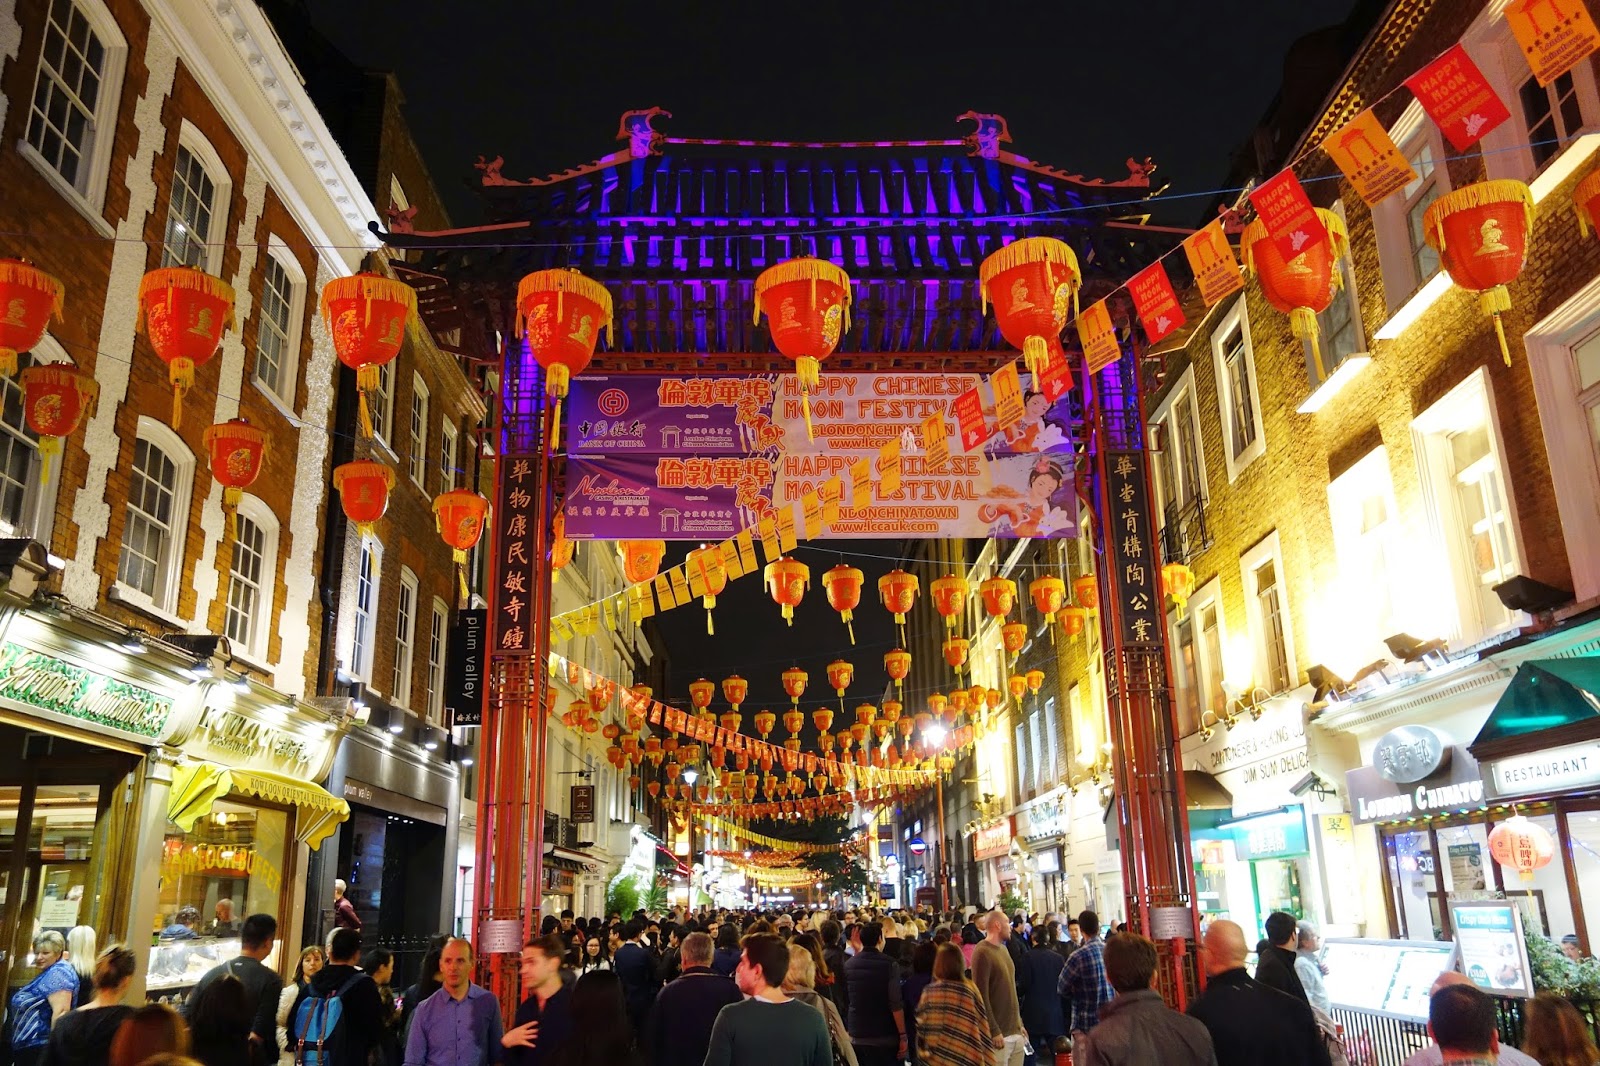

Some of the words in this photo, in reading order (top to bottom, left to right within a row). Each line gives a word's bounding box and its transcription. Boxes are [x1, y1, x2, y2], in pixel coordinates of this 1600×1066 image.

[1420, 57, 1460, 93] HAPPY
[1431, 72, 1466, 102] MOON
[1432, 80, 1480, 116] FESTIVAL
[1259, 179, 1291, 207] HAPPY
[1268, 192, 1295, 217] MOON
[1268, 201, 1305, 229] FESTIVAL
[1136, 271, 1160, 294] HAPPY
[1140, 282, 1162, 303] MOON
[1140, 290, 1169, 314] FESTIVAL
[657, 378, 773, 408] 倫敦華埠
[784, 376, 857, 396] HAPPY
[873, 376, 976, 396] CHINESE
[858, 399, 958, 419] FESTIVA
[578, 420, 646, 438] 中國銀行
[655, 457, 773, 489] 倫敦華埠
[784, 456, 859, 476] HAPPY
[568, 473, 650, 500] Napoleons
[829, 520, 939, 533] www.lccauk.com
[466, 616, 480, 650] plum
[462, 655, 478, 699] valley
[1244, 767, 1257, 784] DIM
[1260, 760, 1278, 780] SUM
[1504, 756, 1589, 783] RESTAURANT
[251, 778, 281, 796] KOWLOON
[282, 786, 310, 803] ORIENTAL
[311, 792, 331, 807] BUFFET
[344, 783, 357, 796] plum
[358, 787, 372, 801] valley
[1415, 780, 1484, 810] CHINATO
[160, 843, 237, 892] KOWLOON
[237, 846, 281, 893] BUFFET
[1460, 916, 1477, 926] Crispy
